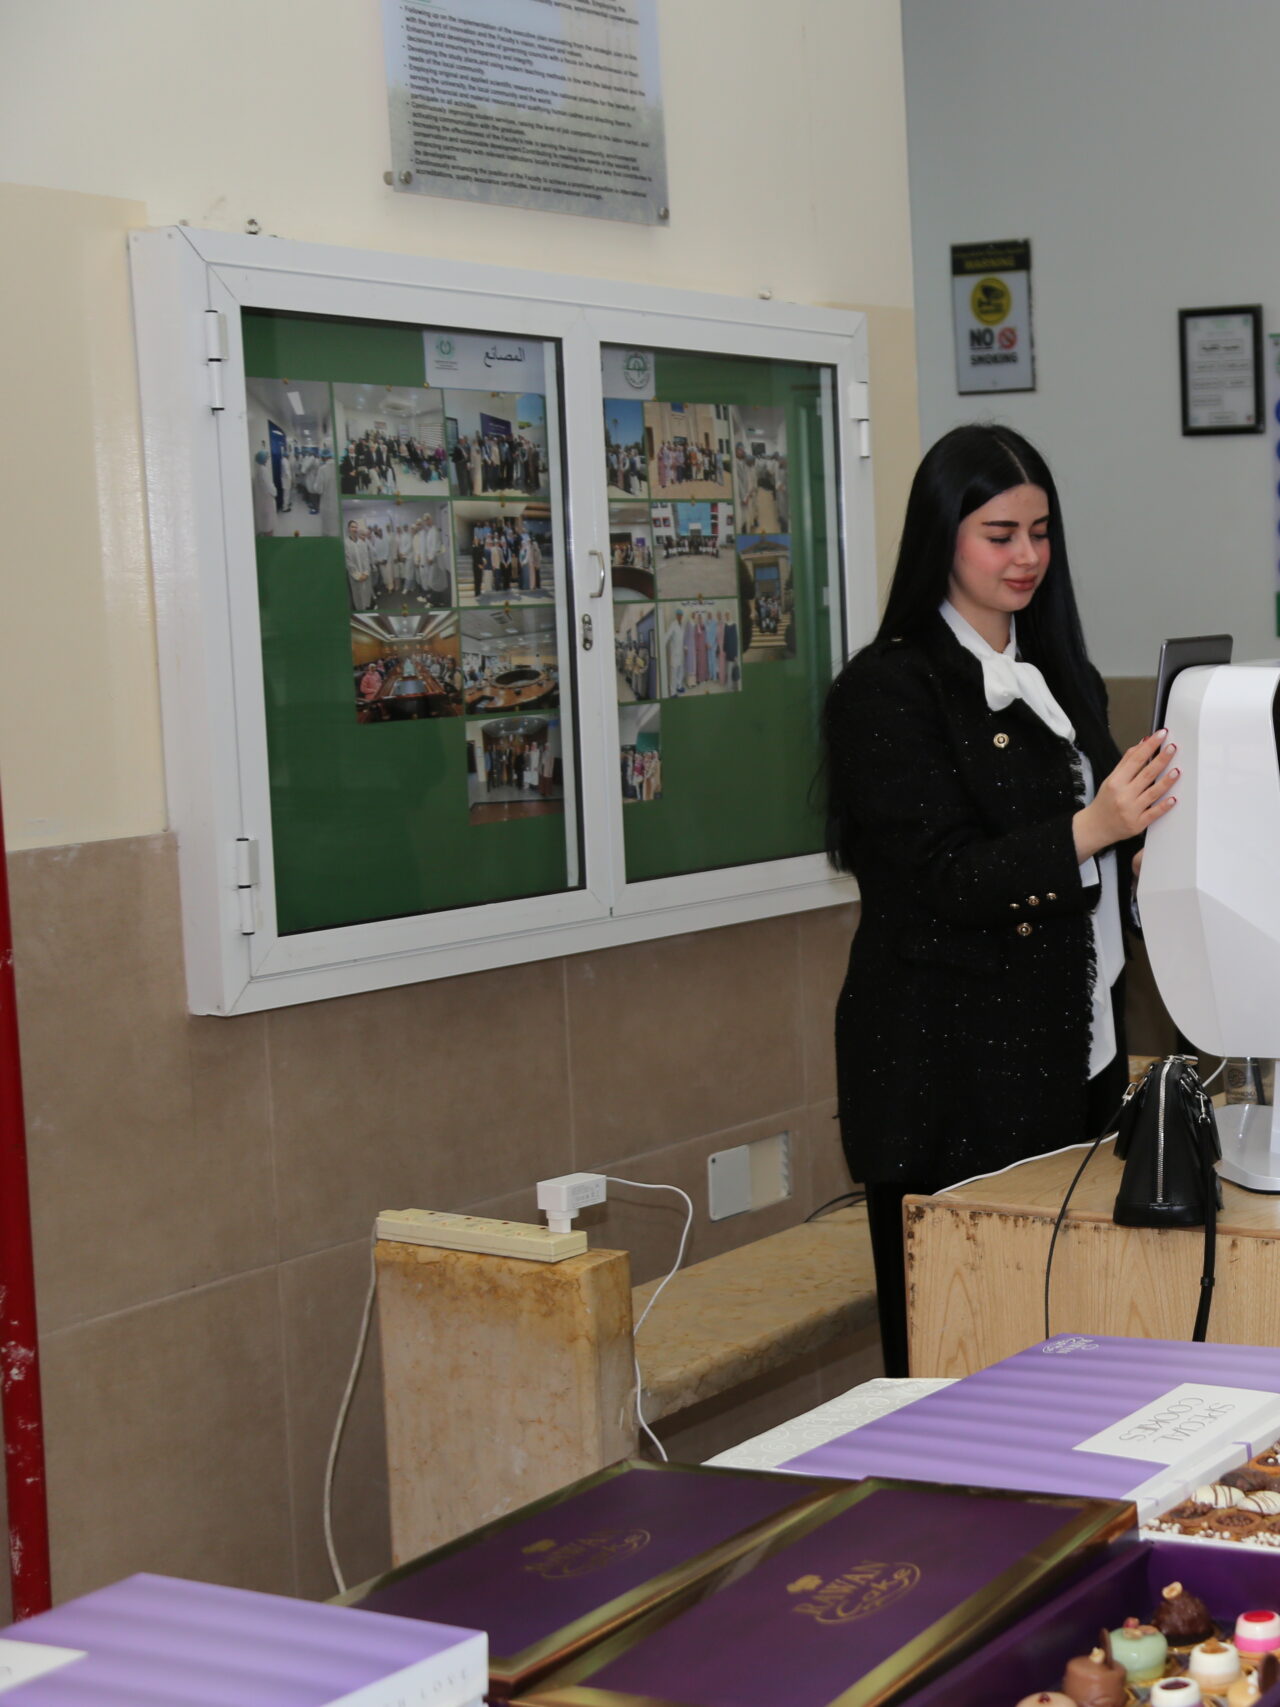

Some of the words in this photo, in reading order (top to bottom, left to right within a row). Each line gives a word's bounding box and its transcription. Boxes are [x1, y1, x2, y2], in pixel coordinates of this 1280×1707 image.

[969, 328, 994, 346] NO
[970, 353, 1018, 366] SMOKING
[1118, 1397, 1204, 1442] COOKIES
[1153, 1402, 1236, 1443] SPECIAL
[792, 1560, 889, 1616] RAWAN
[836, 1567, 912, 1618] Cake
